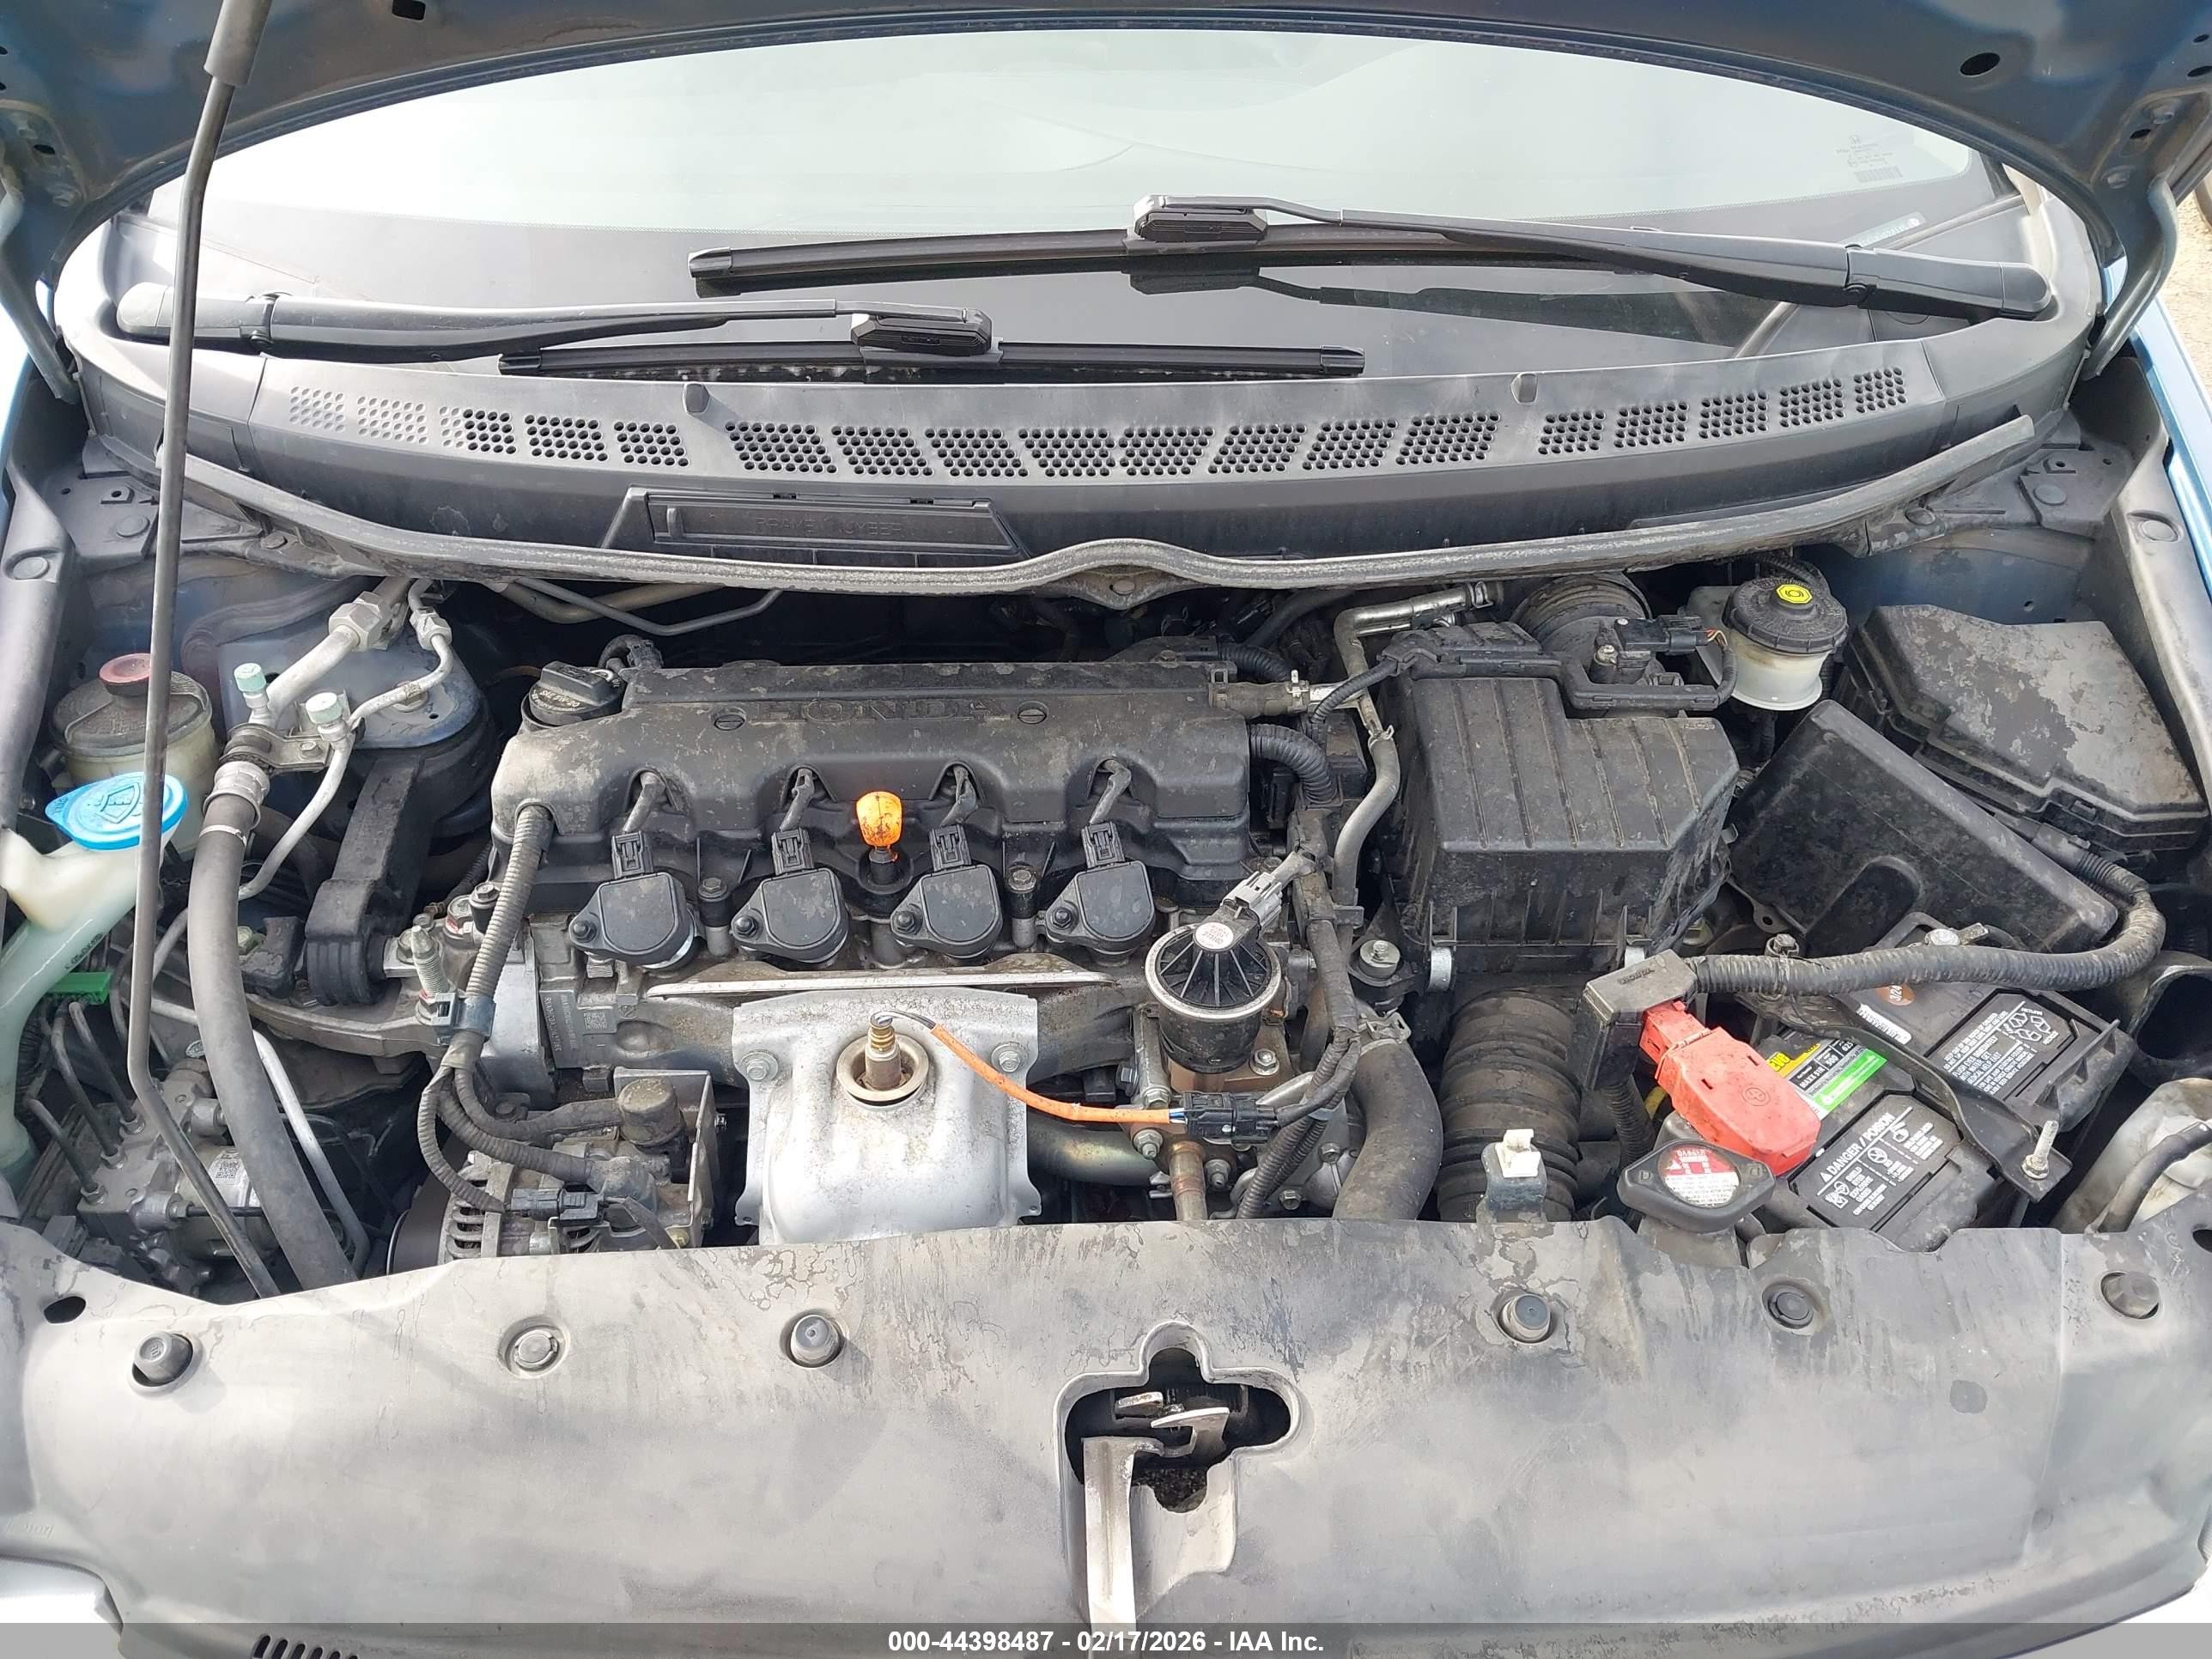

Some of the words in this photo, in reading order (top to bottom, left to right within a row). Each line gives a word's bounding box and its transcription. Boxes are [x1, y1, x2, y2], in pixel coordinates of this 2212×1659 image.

[749, 700, 1012, 723] HONDA
[1842, 1041, 1854, 1051] 625
[1826, 1054, 1839, 1066] 500
[1799, 1073, 1814, 1089] MAXX
[1826, 1143, 1862, 1176] DANGER
[1864, 1112, 1896, 1141] POISON
